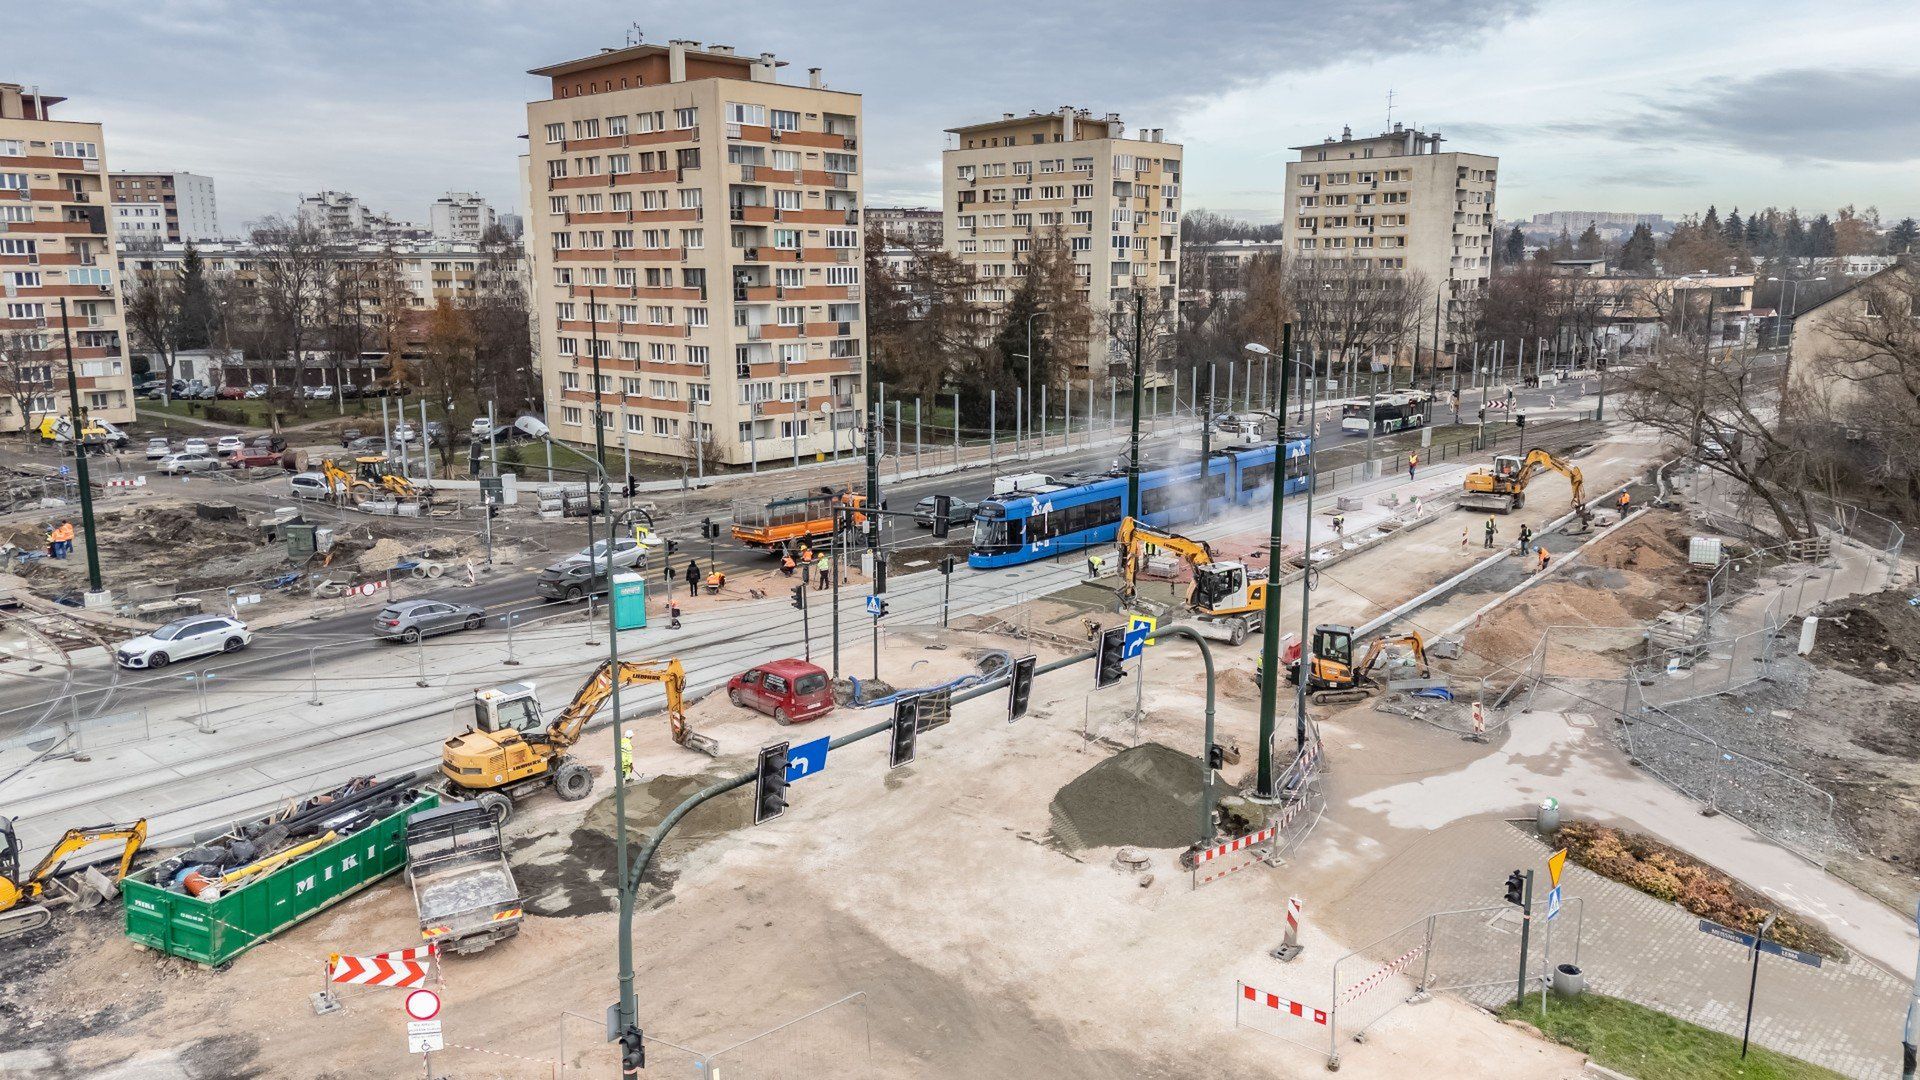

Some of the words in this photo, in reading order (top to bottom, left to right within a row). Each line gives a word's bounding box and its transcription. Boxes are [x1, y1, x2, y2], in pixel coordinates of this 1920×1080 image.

[632, 673, 661, 681] LIEBHERR
[296, 844, 376, 896] MIKI
[134, 899, 155, 911] MIKI
